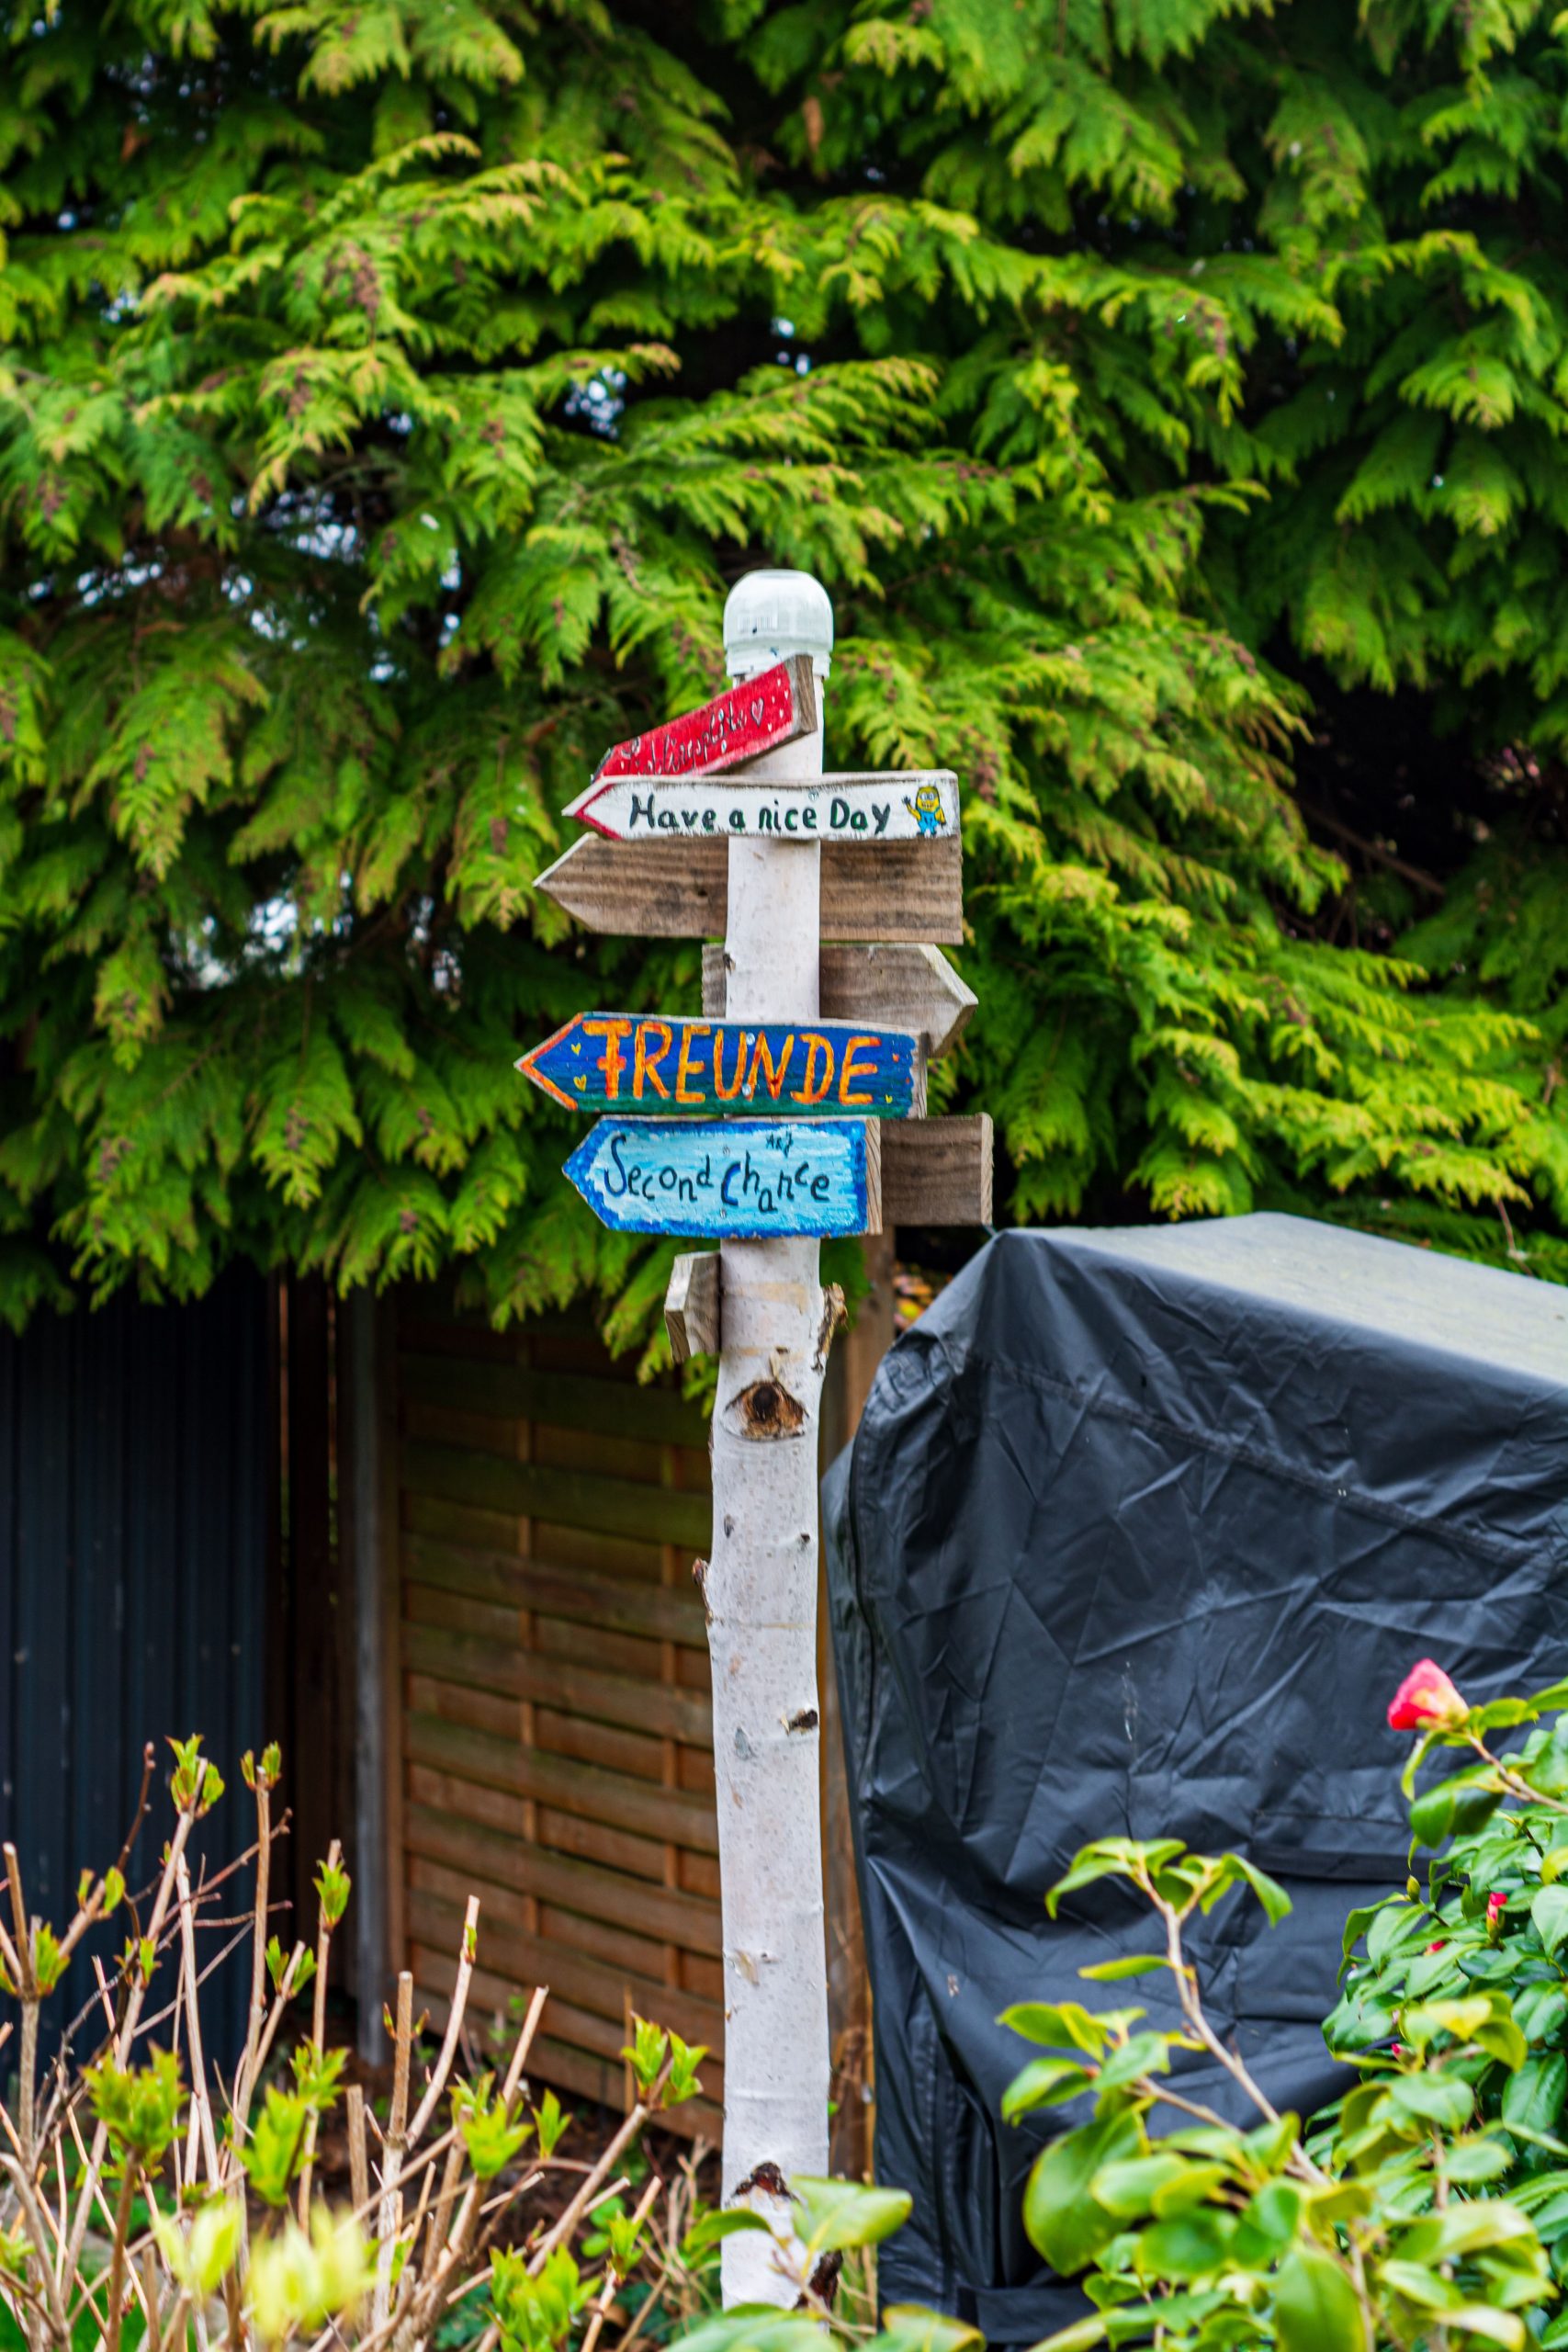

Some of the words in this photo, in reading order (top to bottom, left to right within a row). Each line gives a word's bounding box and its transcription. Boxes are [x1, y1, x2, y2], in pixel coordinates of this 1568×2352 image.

[629, 793, 716, 831] Have
[729, 808, 746, 831] a
[758, 797, 818, 831] nice
[829, 797, 891, 835] Day
[583, 1020, 881, 1103] FREUNDE
[604, 1134, 715, 1203] Second
[721, 1149, 830, 1213] Chance
